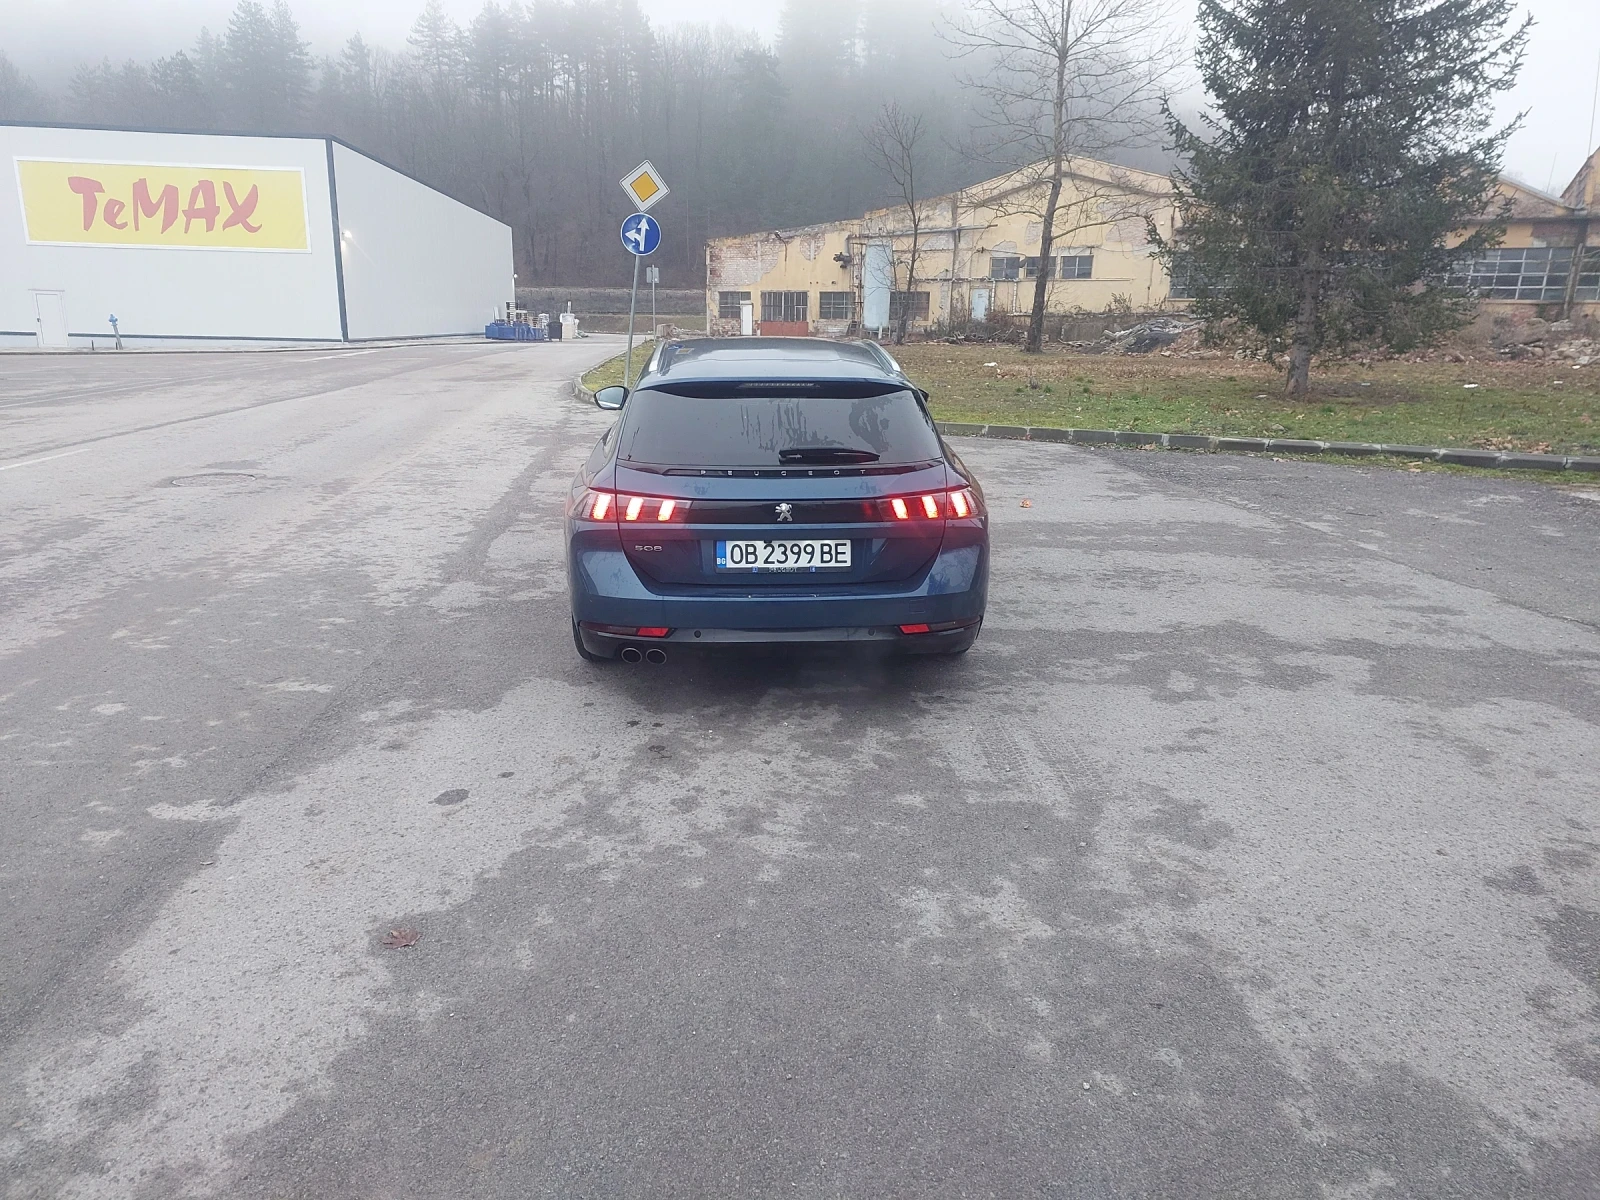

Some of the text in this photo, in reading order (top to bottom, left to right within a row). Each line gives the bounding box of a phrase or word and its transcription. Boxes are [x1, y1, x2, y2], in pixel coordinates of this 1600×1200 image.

[68, 176, 263, 235] TeMAX
[716, 557, 726, 565] BG
[730, 543, 848, 565] OB 2399 BE
